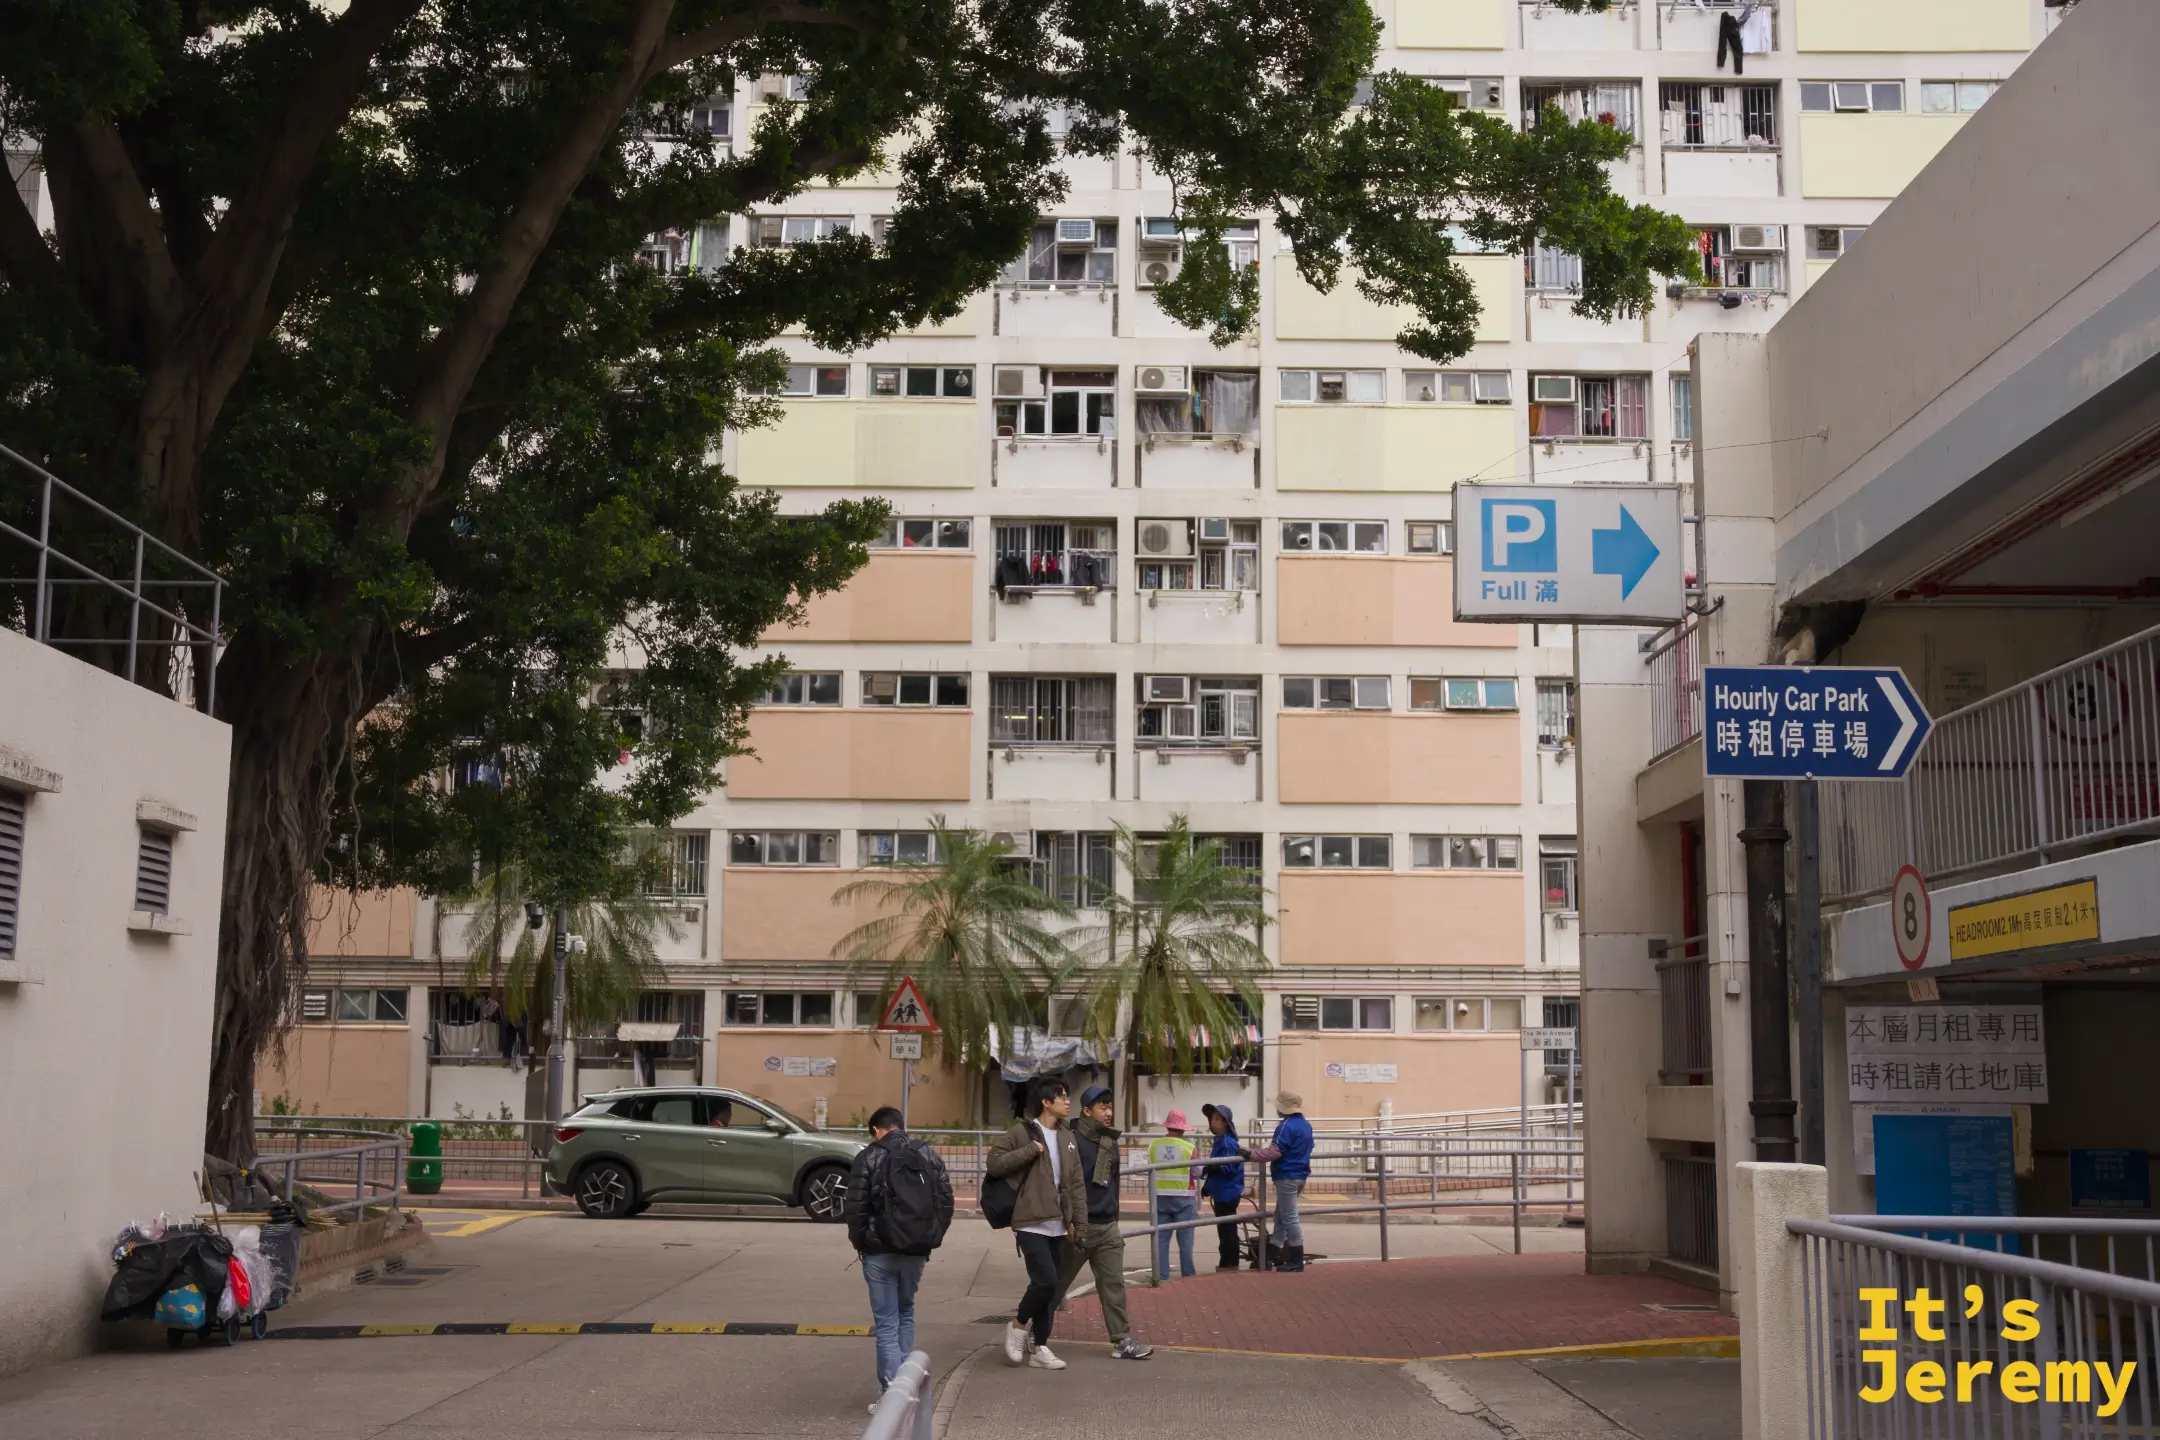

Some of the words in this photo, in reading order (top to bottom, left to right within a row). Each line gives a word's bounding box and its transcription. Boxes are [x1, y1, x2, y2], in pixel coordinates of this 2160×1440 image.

[1492, 504, 1546, 566] P
[1482, 580, 1526, 600] Full
[1535, 580, 1558, 602] 滿
[1715, 685, 1779, 717] Hourly
[1785, 686, 1819, 711] Car
[1825, 686, 1869, 712] Park
[2068, 681, 2096, 722] 8
[1716, 718, 1869, 759] 時租停車場
[1903, 891, 1918, 941] 8
[1849, 1012, 2039, 1044] 本層月租專用
[1851, 1061, 2045, 1092] 時租請往地庫
